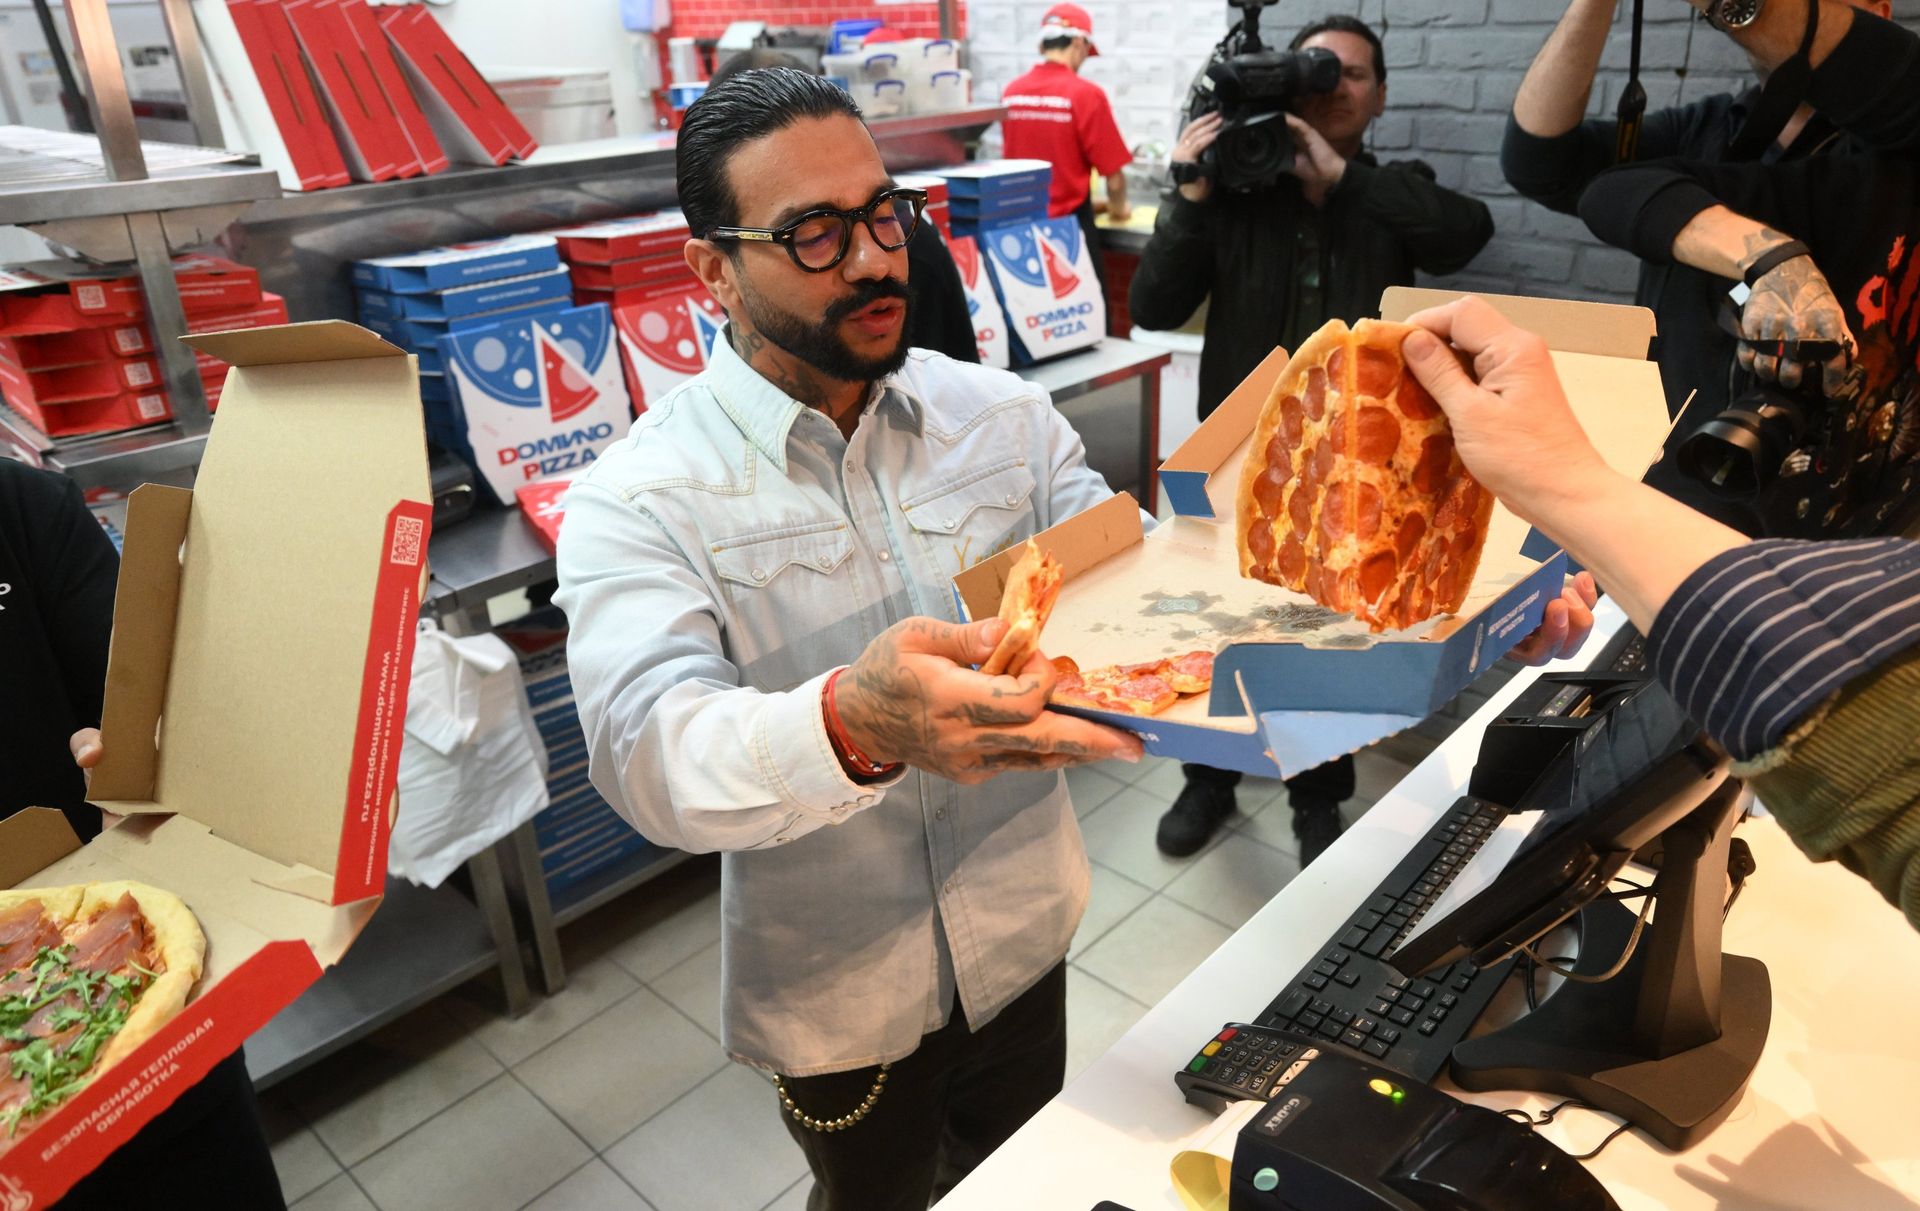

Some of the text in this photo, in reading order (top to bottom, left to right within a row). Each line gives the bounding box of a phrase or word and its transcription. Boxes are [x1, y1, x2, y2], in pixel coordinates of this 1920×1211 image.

[522, 448, 598, 480] PIZZA
[394, 587, 410, 664] заказывайте
[361, 651, 391, 822] www.dominopizza.ru
[386, 682, 397, 718] сайте
[41, 1018, 214, 1162] БЕЗОПАСНАЯ ТЕПЛОВАЯ
[96, 1062, 181, 1133] ОБРАБОТКА
